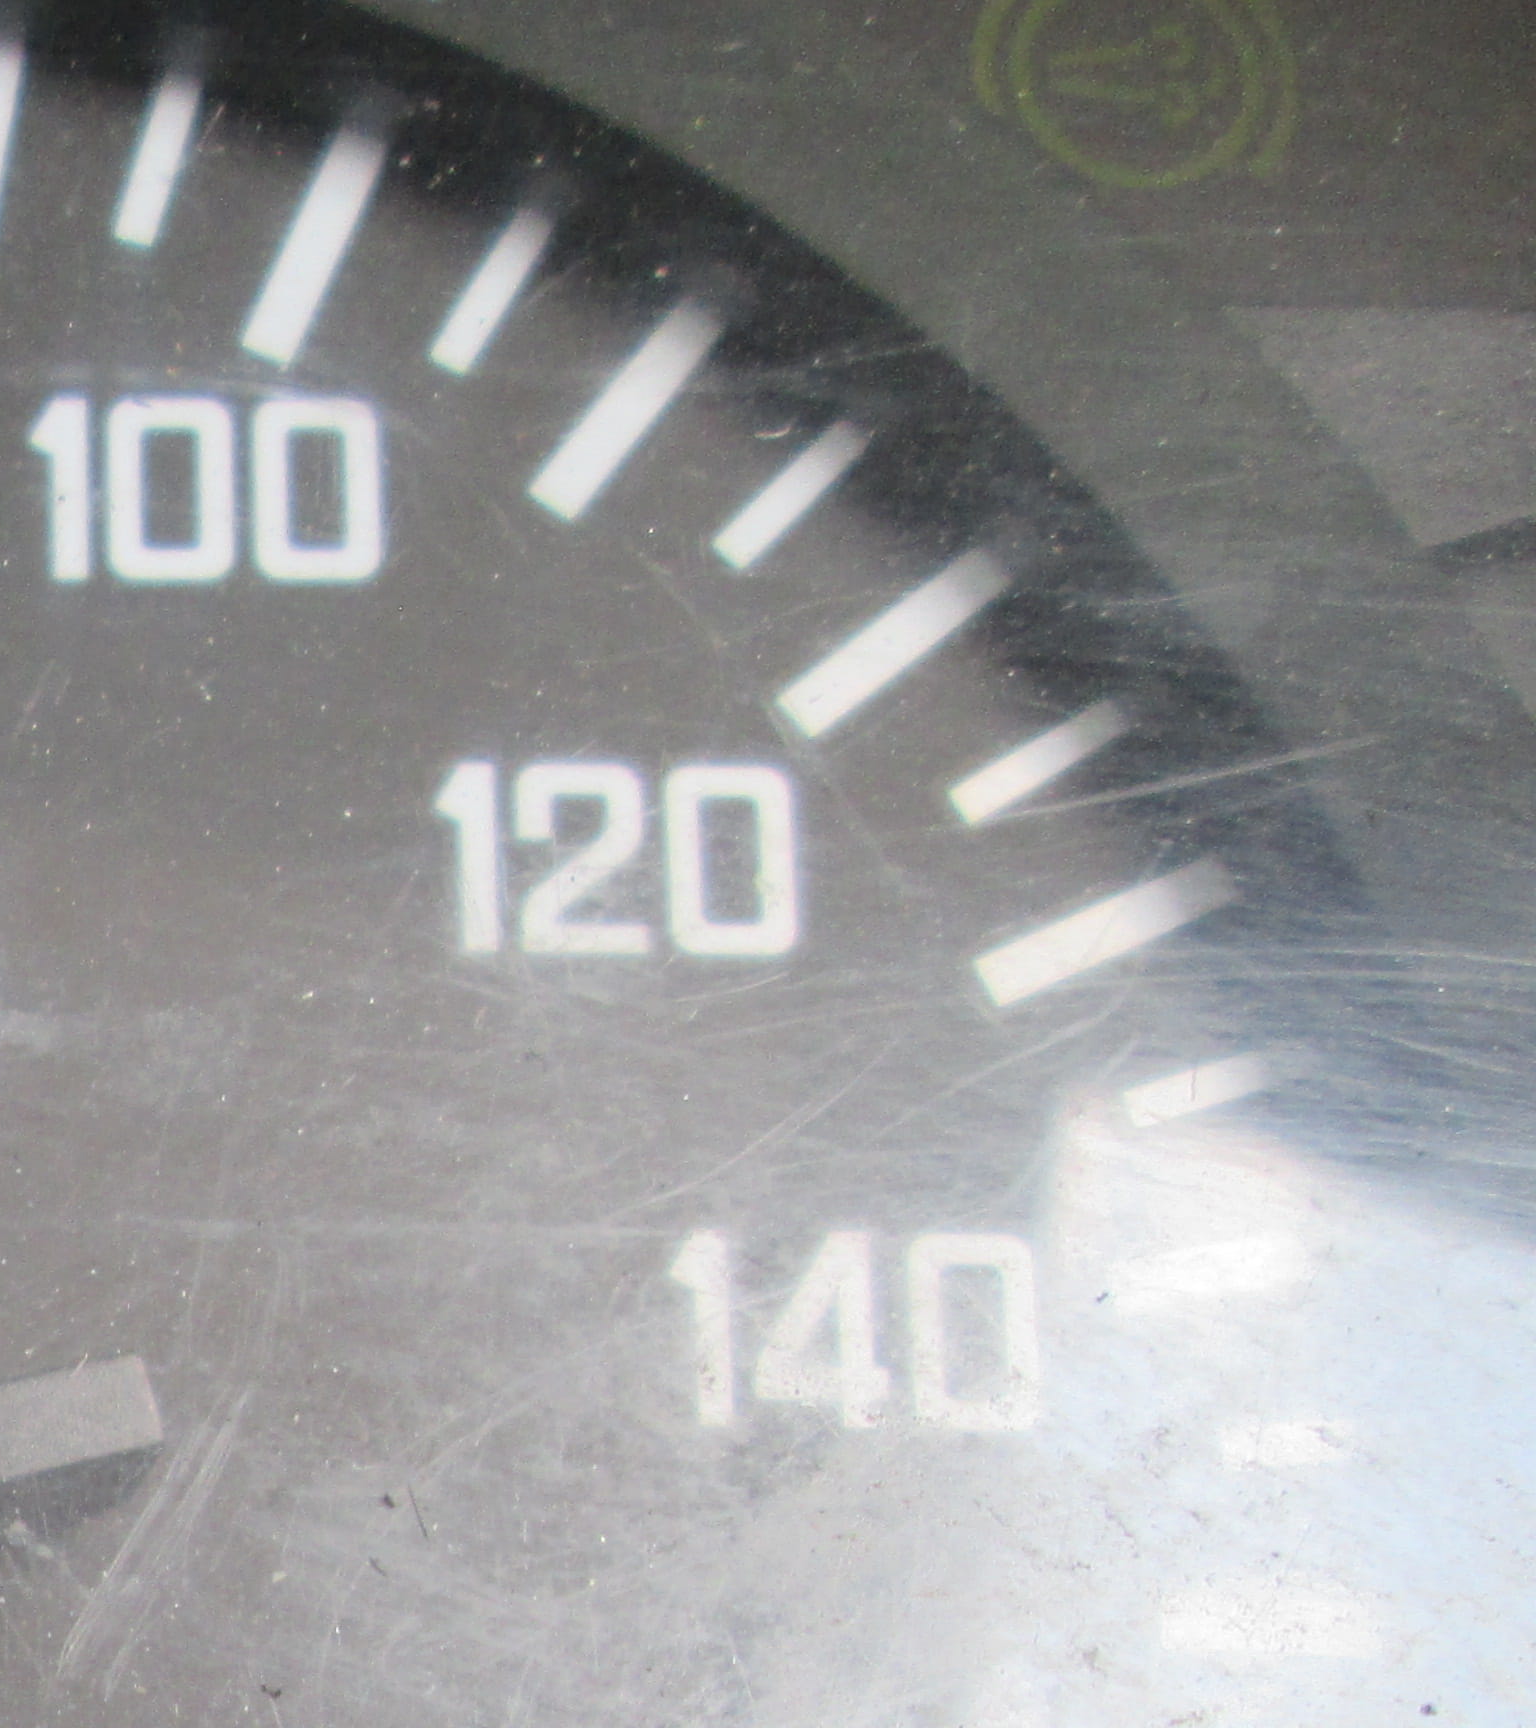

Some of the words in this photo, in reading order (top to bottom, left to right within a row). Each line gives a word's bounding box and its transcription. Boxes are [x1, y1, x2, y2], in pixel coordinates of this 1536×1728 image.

[28, 393, 385, 582] 100
[435, 760, 798, 956] 120
[667, 1227, 1044, 1432] 140
